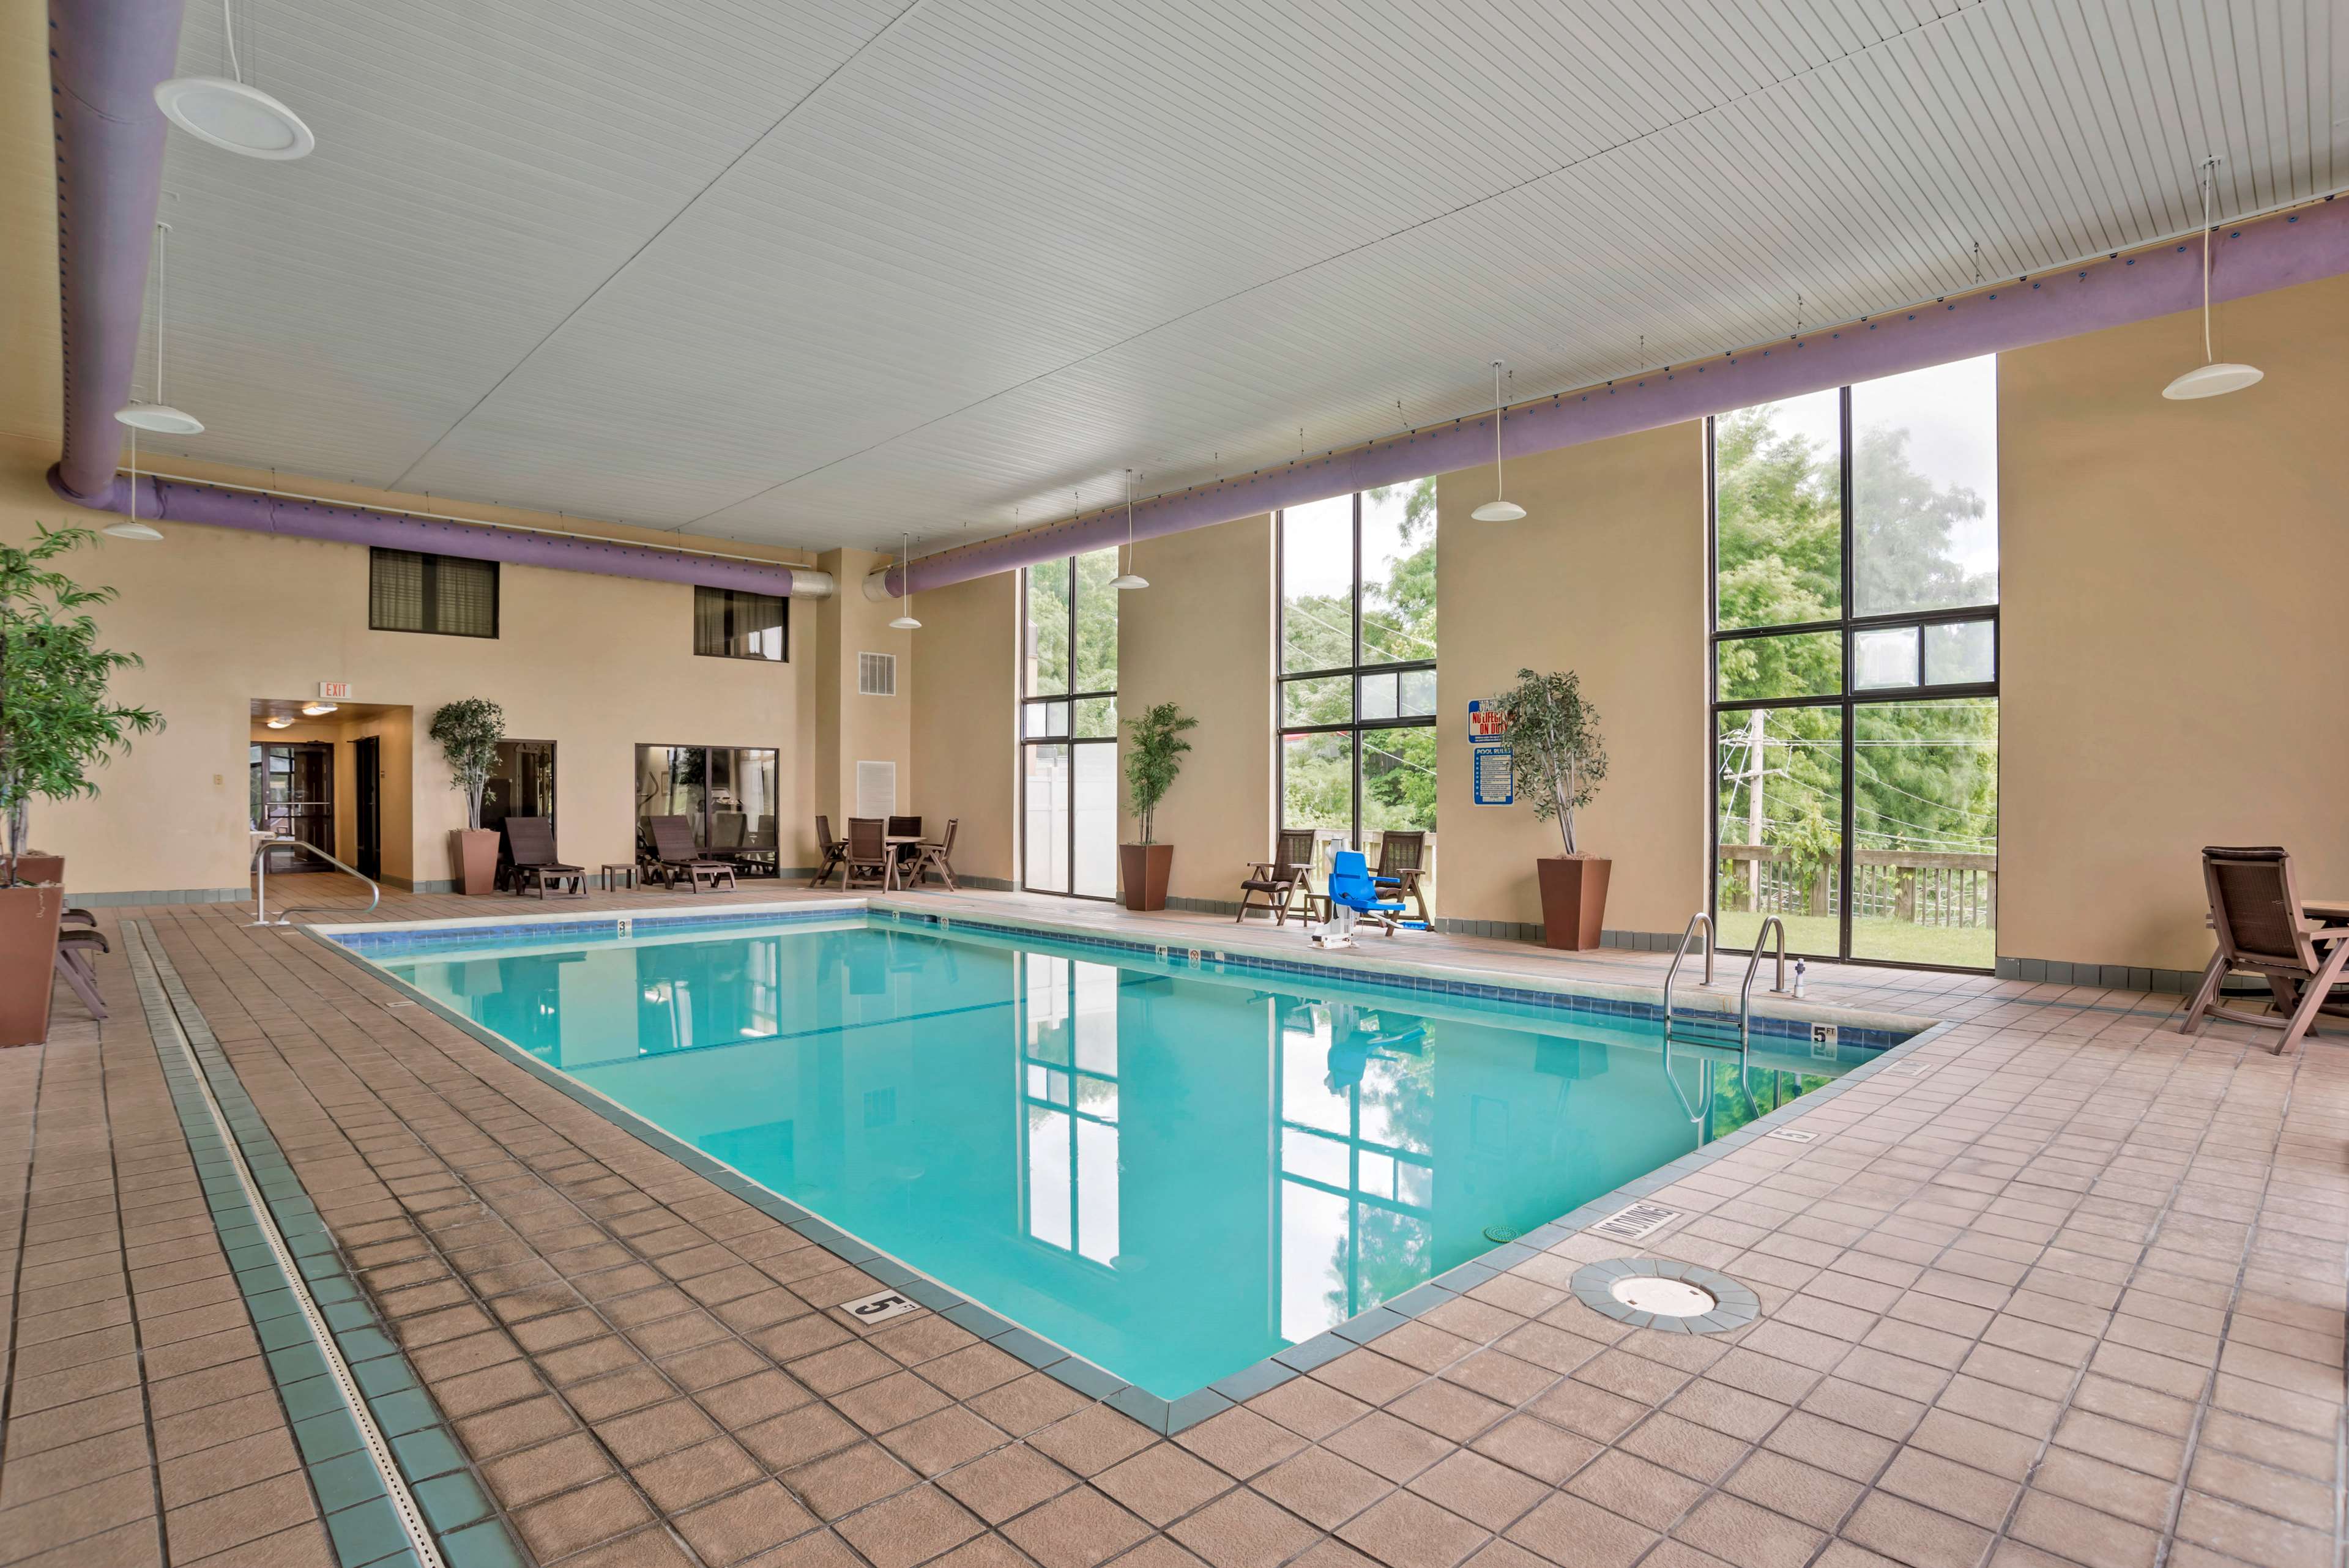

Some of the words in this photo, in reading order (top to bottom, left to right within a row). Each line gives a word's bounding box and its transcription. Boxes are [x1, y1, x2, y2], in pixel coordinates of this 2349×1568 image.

[326, 683, 347, 696] EXIT
[1473, 712, 1481, 724] NO
[1480, 723, 1488, 734] ON
[619, 921, 625, 930] 3
[1814, 1026, 1826, 1042] 5
[1613, 1205, 1674, 1230] DIVING
[1599, 1222, 1642, 1237] NO
[855, 1296, 906, 1315] 5
